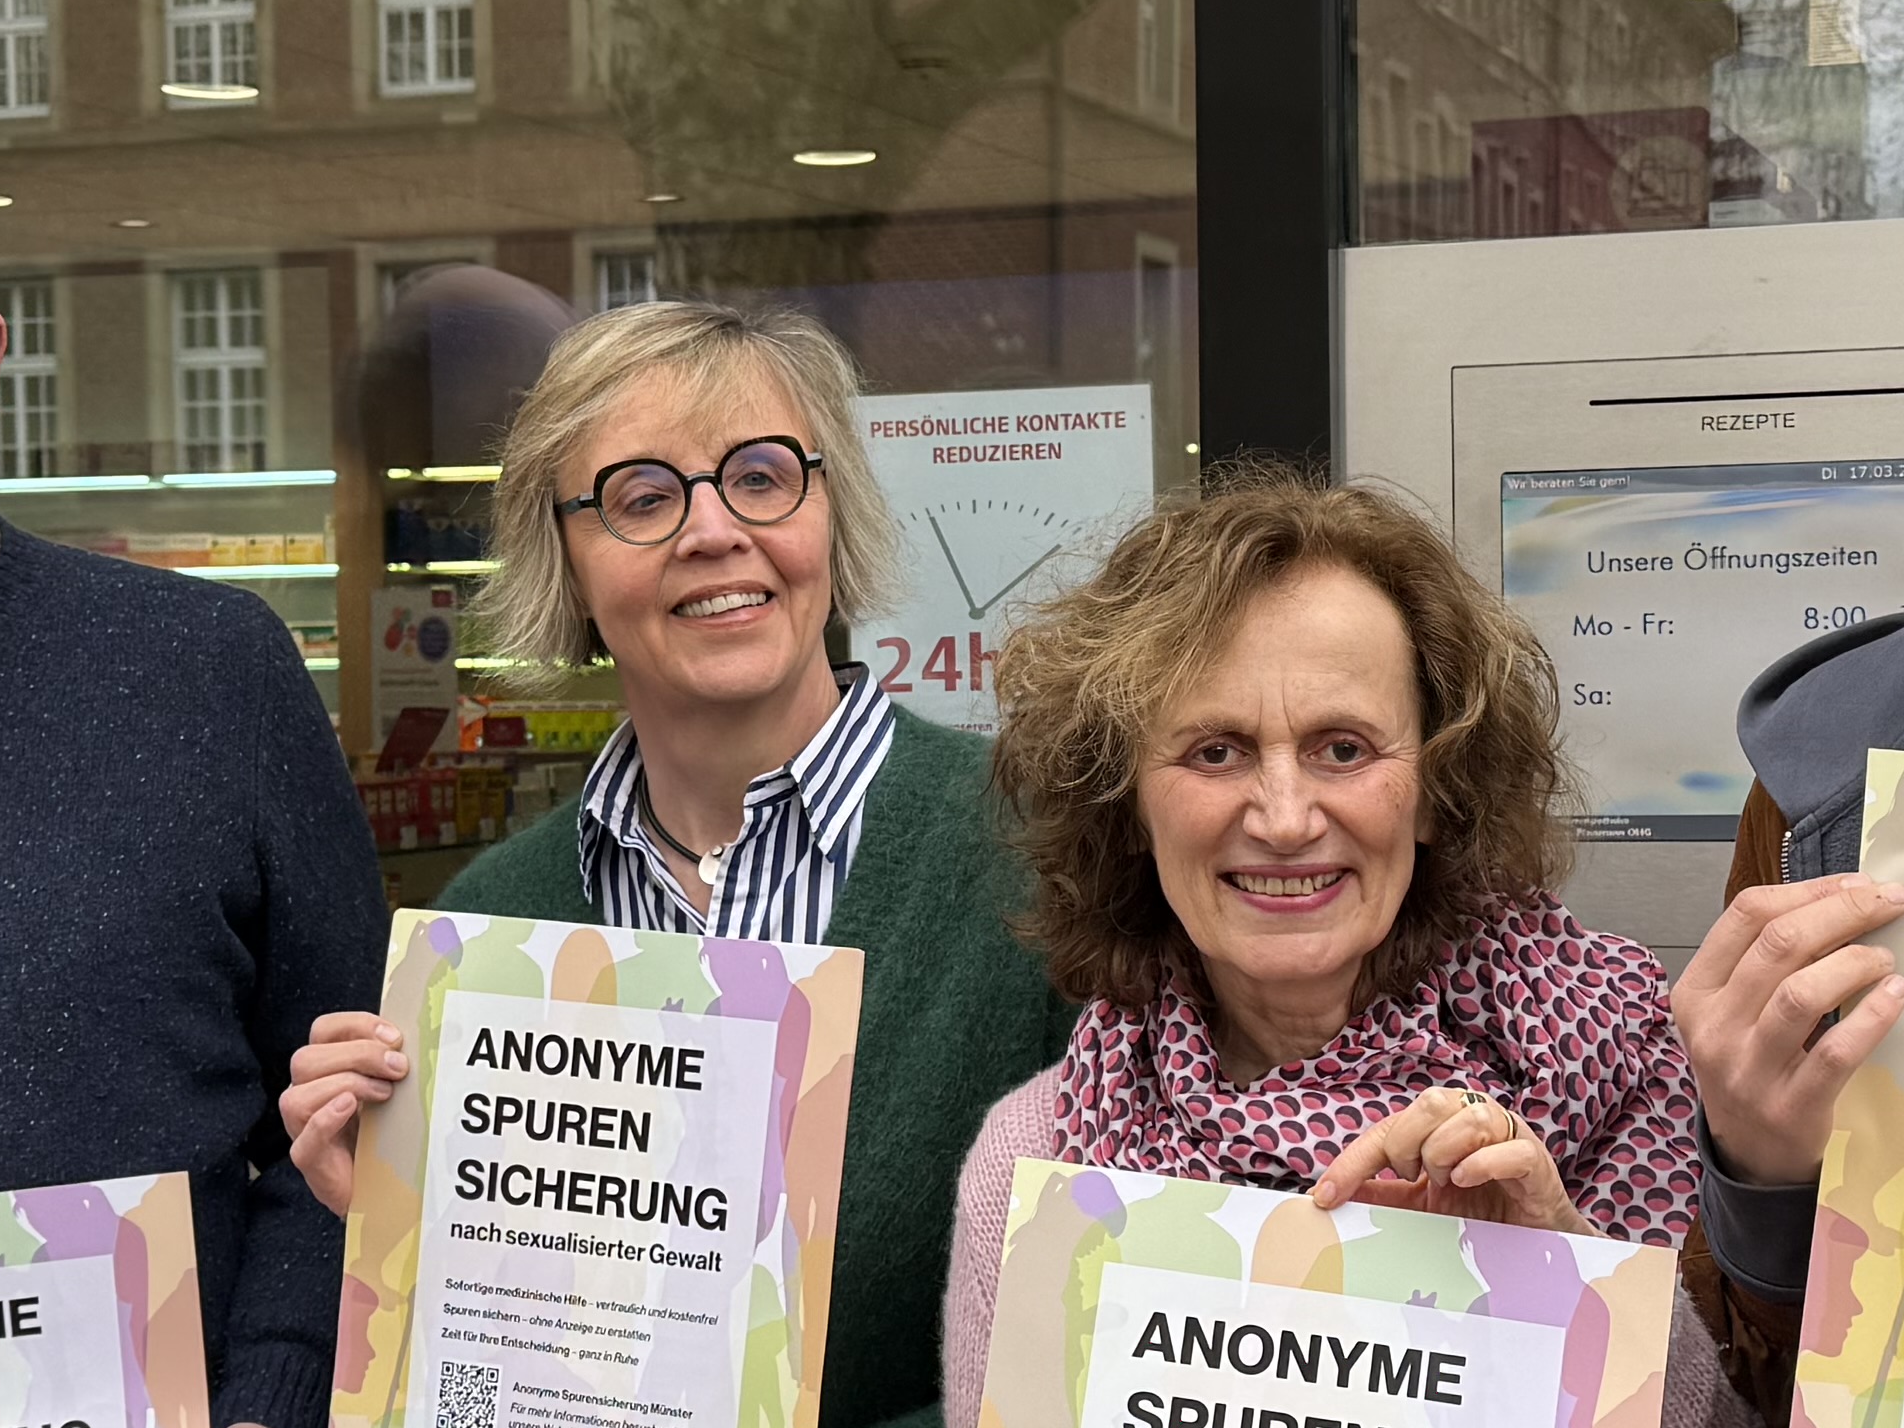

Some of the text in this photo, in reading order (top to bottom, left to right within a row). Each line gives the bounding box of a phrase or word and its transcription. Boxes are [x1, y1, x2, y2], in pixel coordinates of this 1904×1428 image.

[870, 410, 1128, 439] PERSÖNLICHE KONTAKTE
[1701, 412, 1797, 432] REZEPTE
[932, 442, 1063, 465] REDUZIEREN
[1507, 478, 1528, 490] Wir
[1530, 475, 1576, 490] beraten
[1578, 475, 1596, 488] Sie
[1587, 542, 1878, 574] Unsere Öffnungszeiten
[1573, 615, 1613, 636] Mo
[1642, 613, 1675, 636] Fr:
[1804, 606, 1867, 630] 8:00
[1573, 684, 1612, 706] Sa:
[466, 1027, 705, 1091] ANONYME
[460, 1092, 652, 1153] SPUREN
[454, 1158, 728, 1232] SICHERUNG
[450, 1221, 723, 1273] nach sexualisierter Gewalt
[1131, 1311, 1467, 1406] ANONYME
